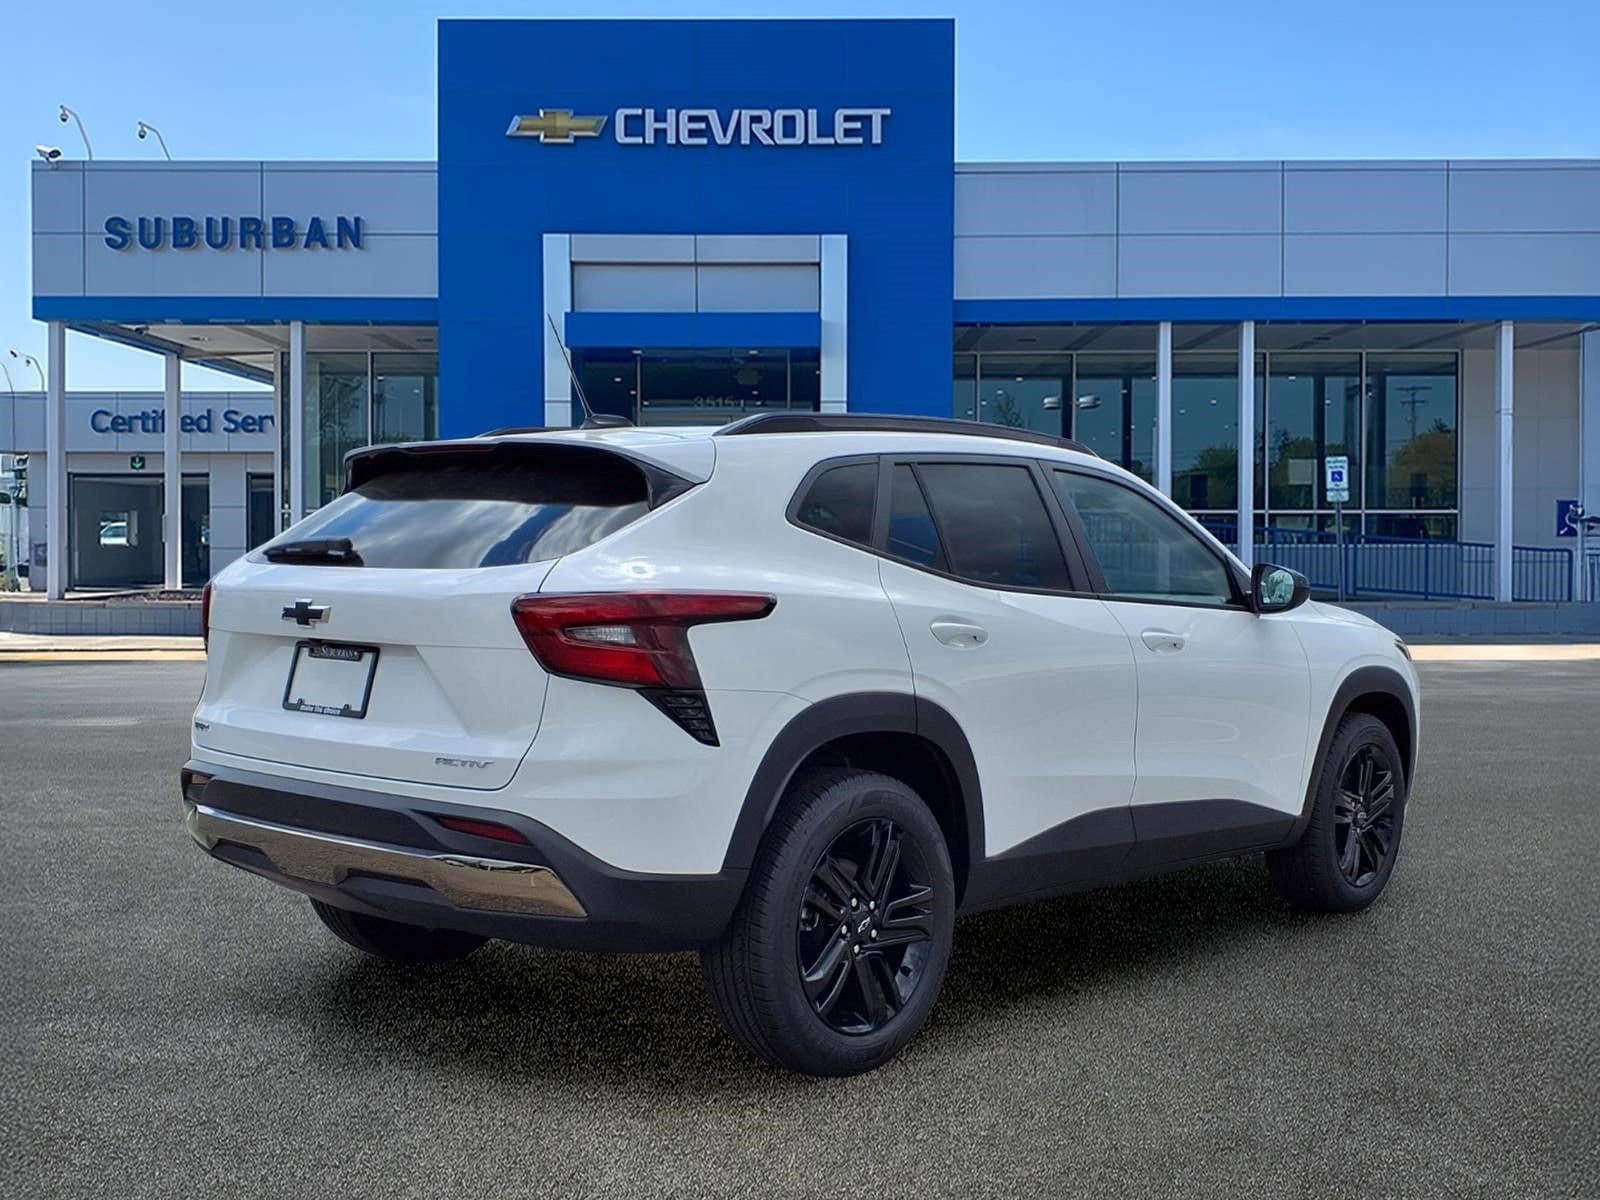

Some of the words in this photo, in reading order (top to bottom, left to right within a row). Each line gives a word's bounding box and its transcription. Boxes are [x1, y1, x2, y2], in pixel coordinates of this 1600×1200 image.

[614, 107, 892, 146] CHEVROLET
[103, 215, 362, 251] SUBURBAN
[90, 408, 212, 434] Certifed
